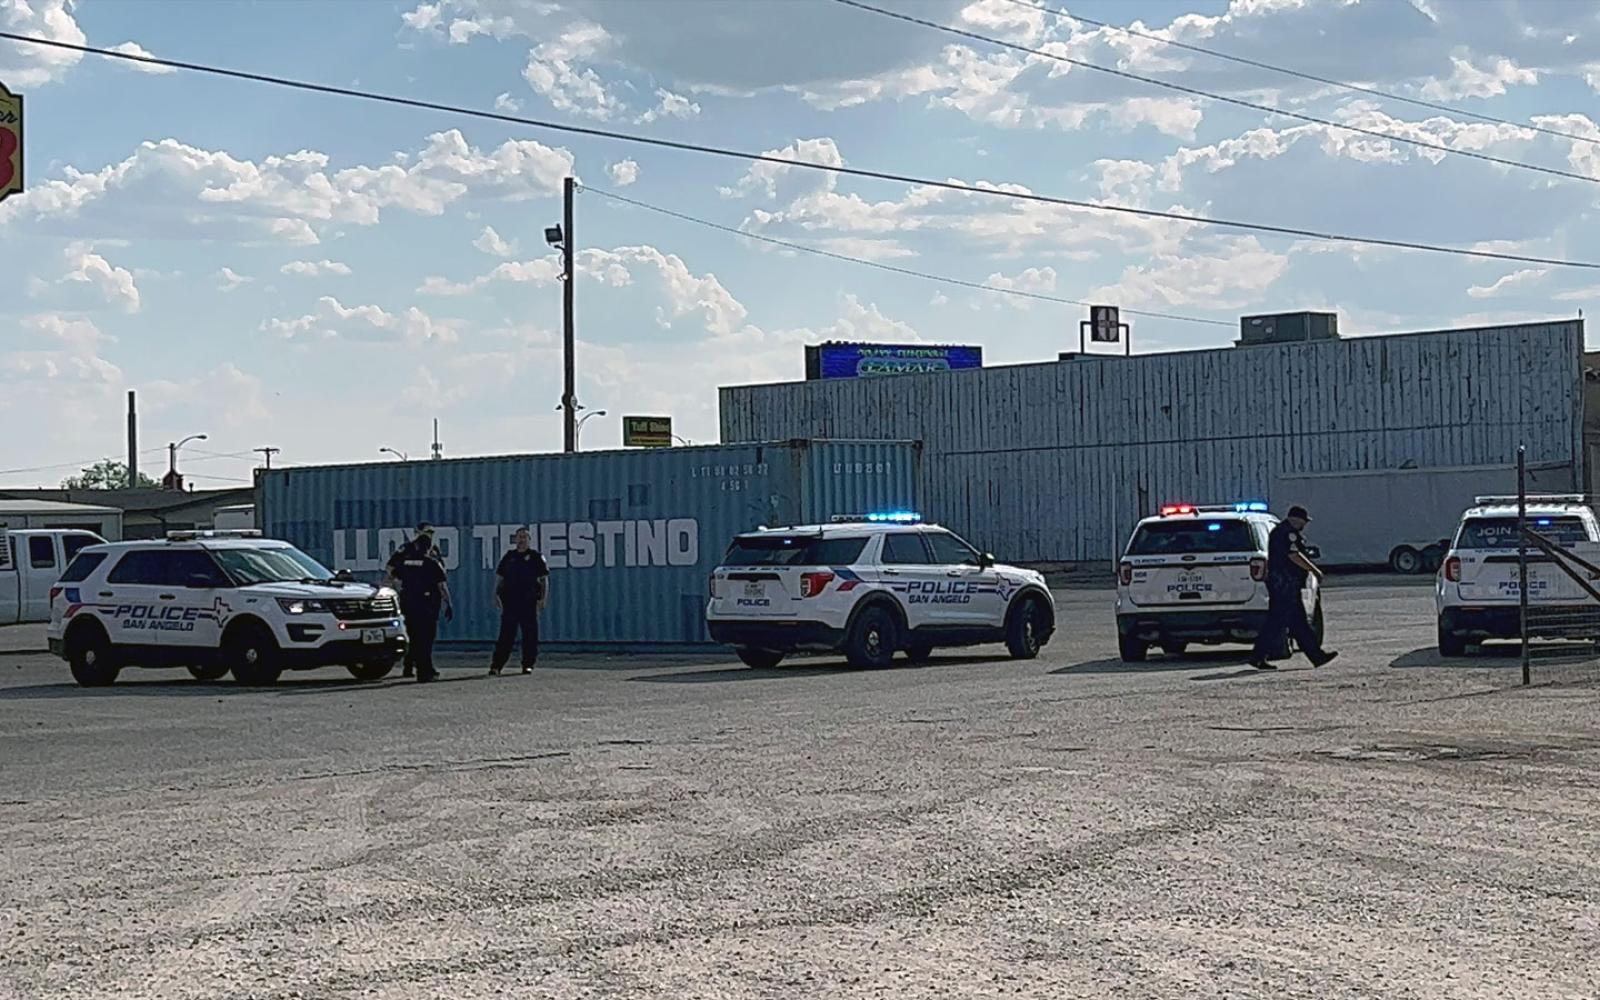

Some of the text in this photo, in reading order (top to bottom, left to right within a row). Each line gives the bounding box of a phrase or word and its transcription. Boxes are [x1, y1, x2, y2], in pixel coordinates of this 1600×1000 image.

[1477, 527, 1511, 537] JOIN
[906, 581, 979, 594] POLICE
[1167, 583, 1213, 593] POLICE
[1499, 581, 1547, 590] POCE
[736, 598, 770, 607] POLICE
[908, 594, 971, 604] SAN ANGELO
[114, 605, 199, 621] POLICE
[122, 619, 195, 632] SAN ANGELO
